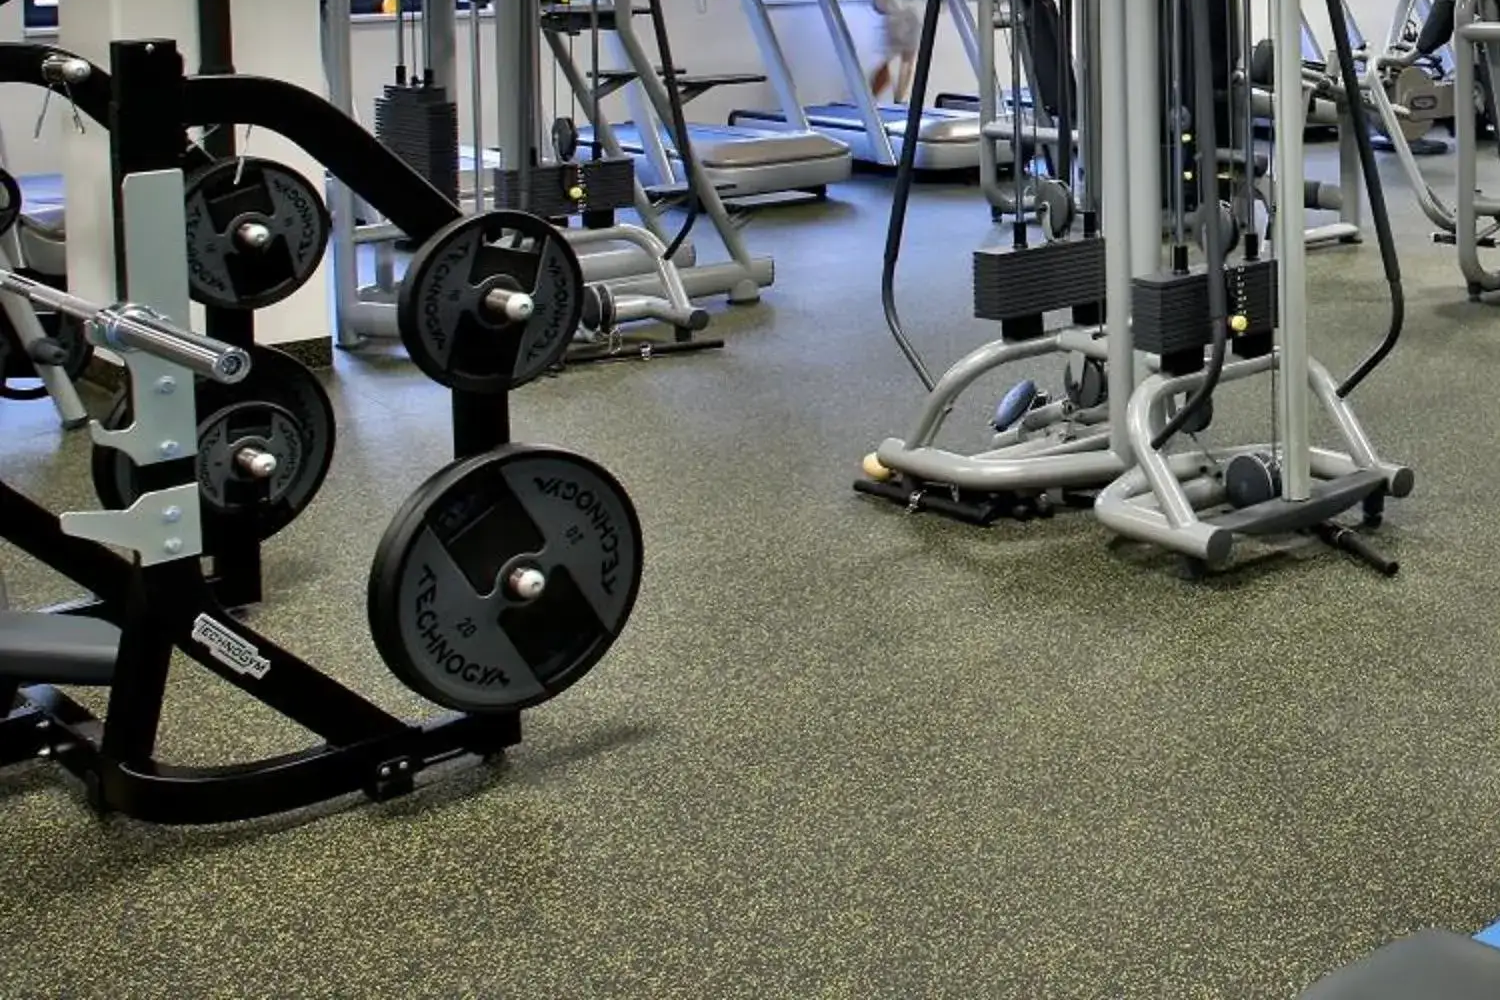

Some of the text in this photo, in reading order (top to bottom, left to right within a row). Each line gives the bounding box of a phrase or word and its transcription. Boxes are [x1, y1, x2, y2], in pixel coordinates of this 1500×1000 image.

[533, 475, 620, 597] TECHNOGYM
[416, 564, 511, 688] TECHNOGYM
[456, 616, 478, 638] 20
